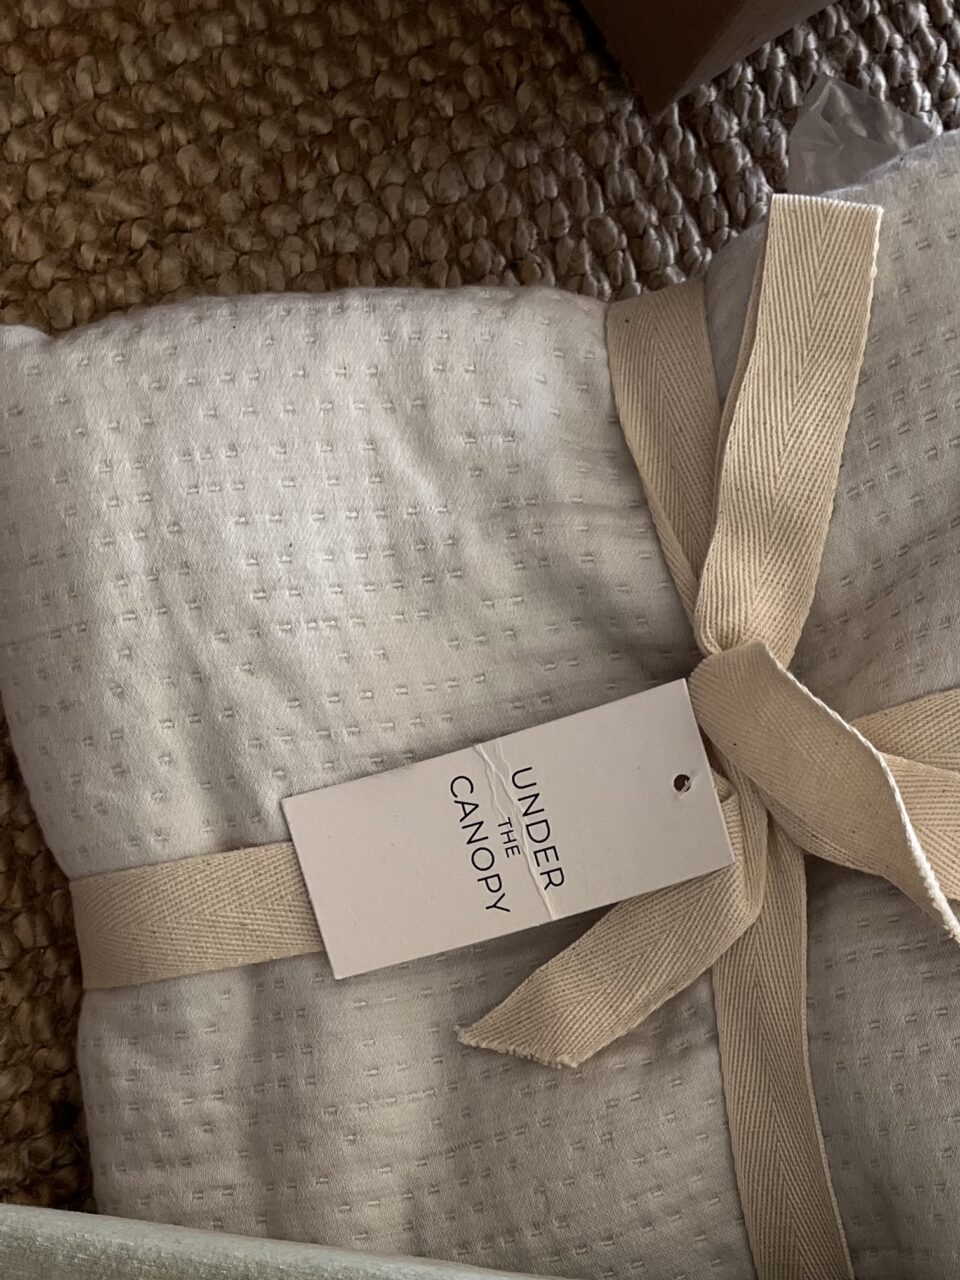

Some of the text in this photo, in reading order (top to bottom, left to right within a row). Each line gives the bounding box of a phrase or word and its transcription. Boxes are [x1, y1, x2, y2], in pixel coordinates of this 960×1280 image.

[450, 775, 511, 912] CANOPY
[497, 816, 521, 858] THE
[511, 766, 565, 891] UNDER
